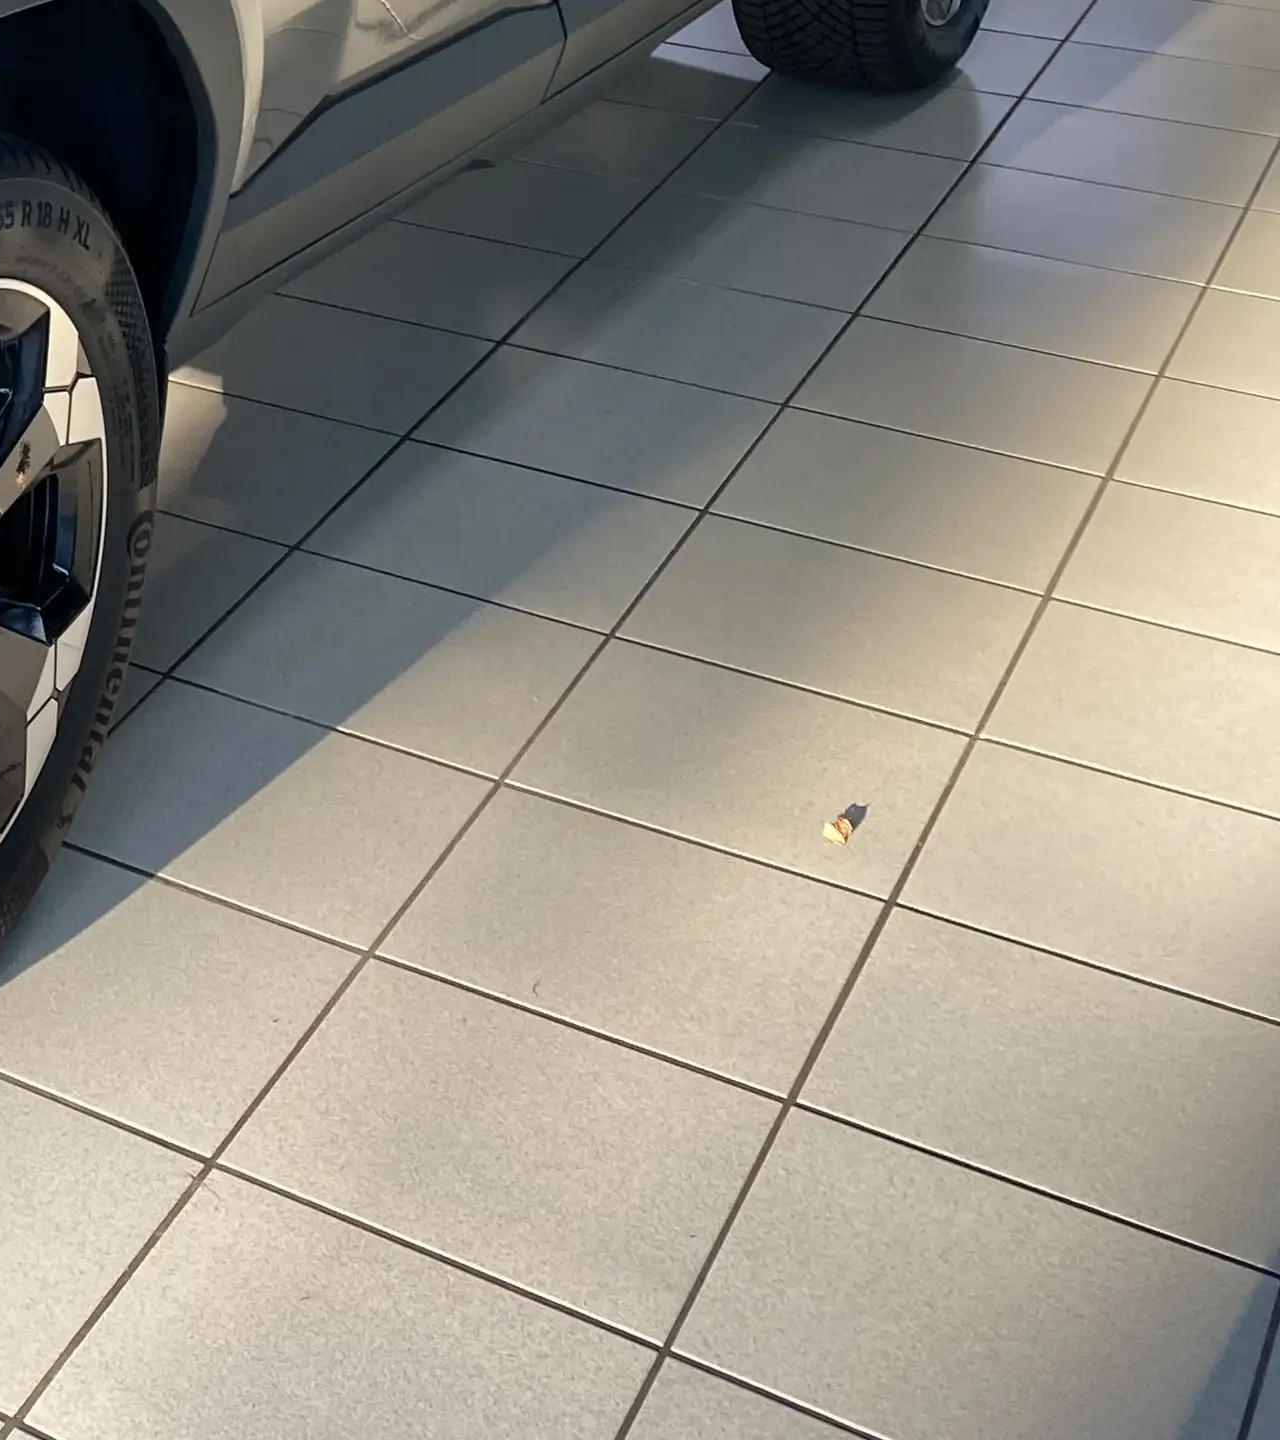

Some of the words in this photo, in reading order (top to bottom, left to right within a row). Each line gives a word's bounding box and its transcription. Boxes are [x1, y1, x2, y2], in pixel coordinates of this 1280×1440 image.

[20, 199, 33, 228] R
[36, 201, 53, 229] 18
[59, 205, 71, 236] H
[72, 215, 91, 251] XL
